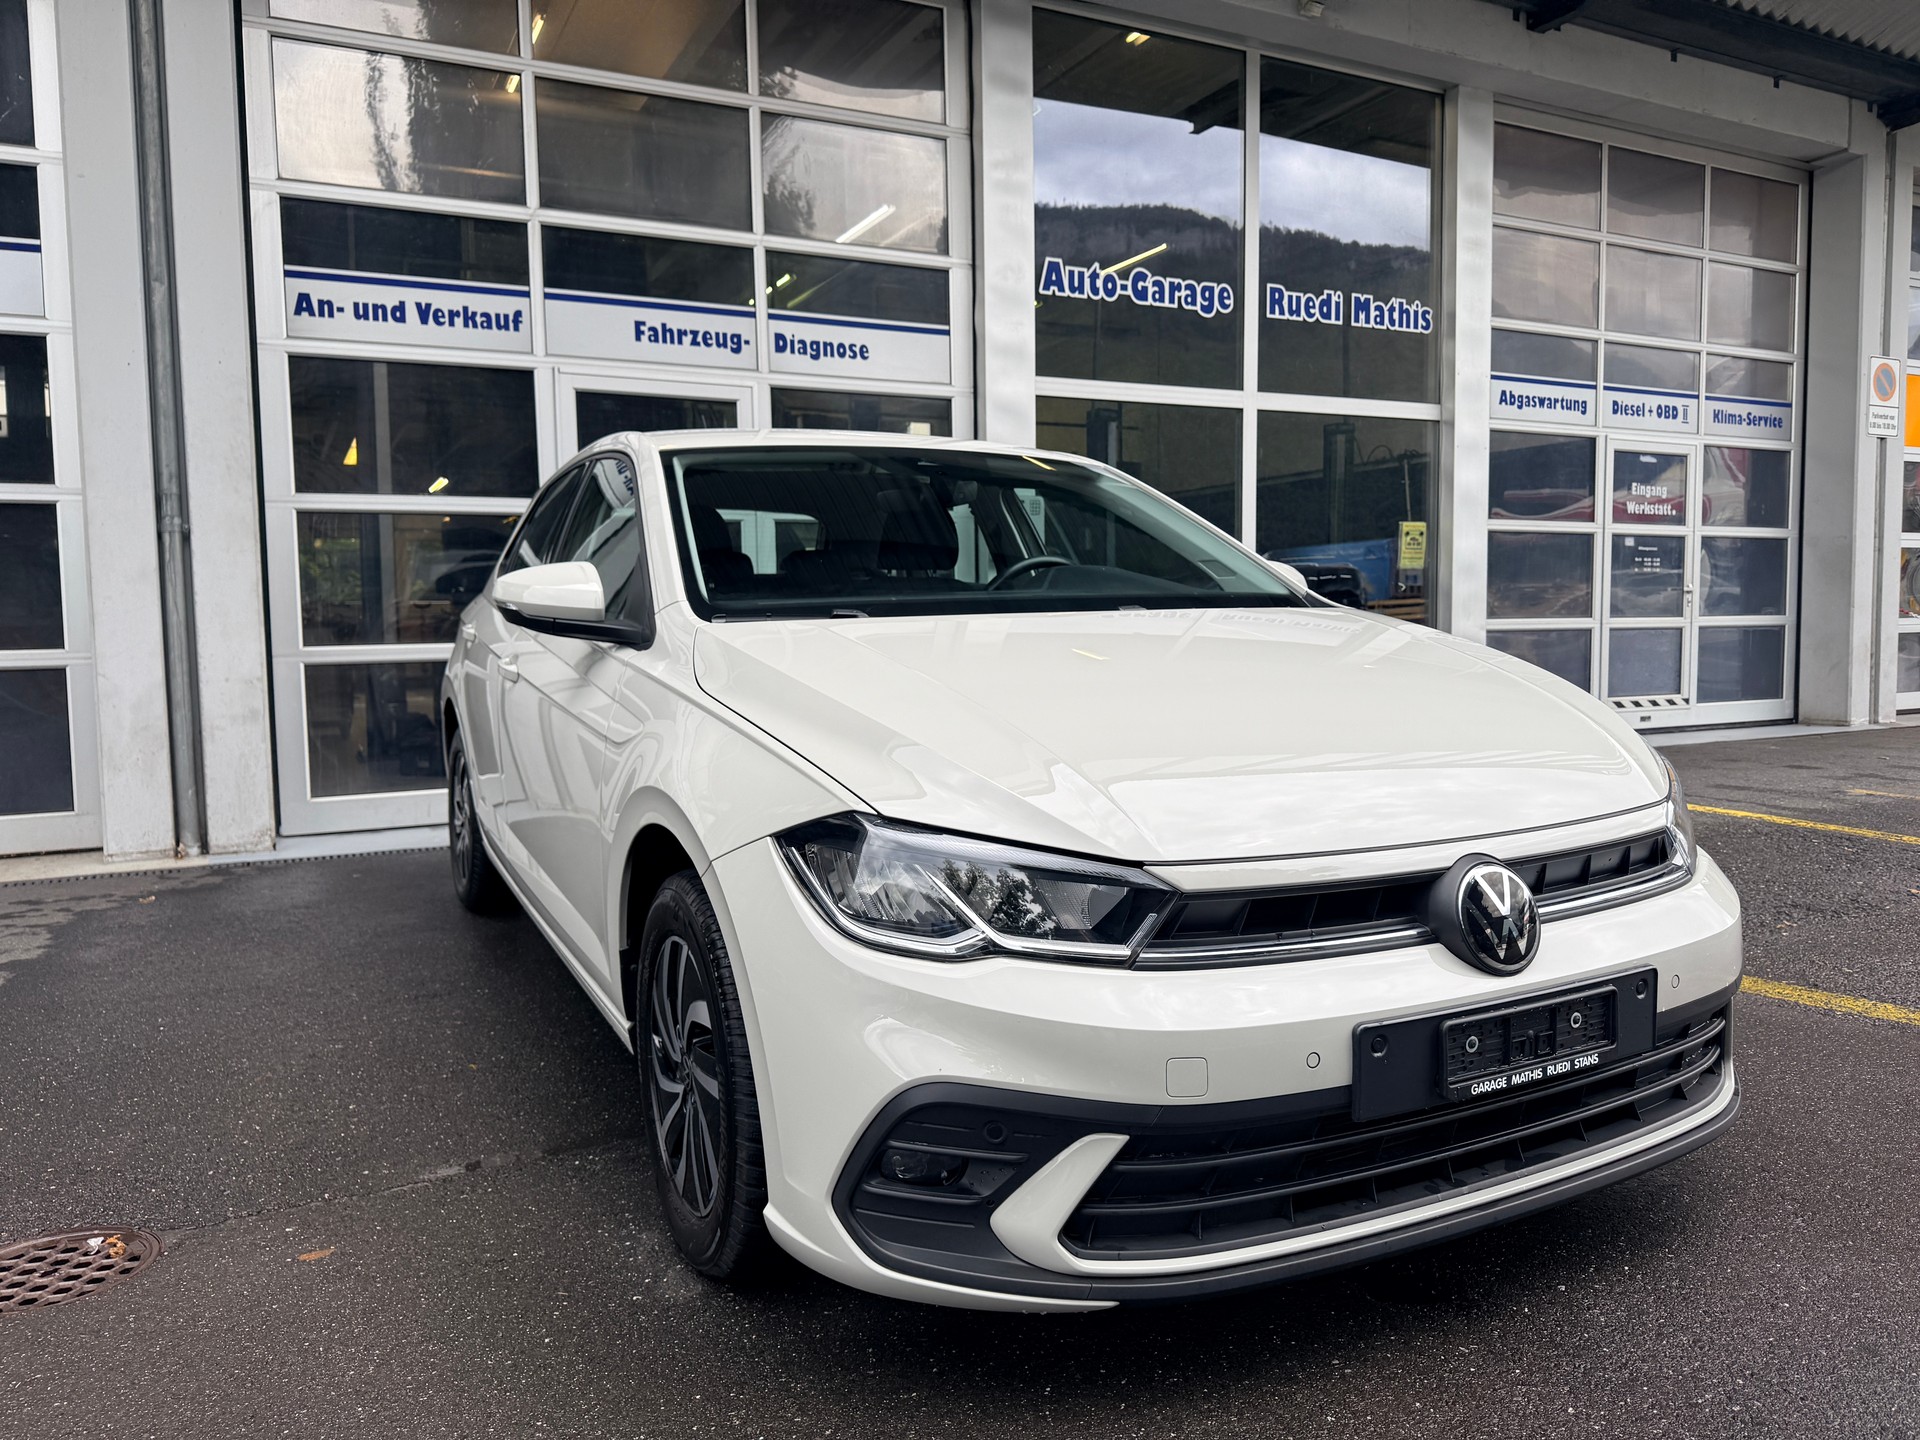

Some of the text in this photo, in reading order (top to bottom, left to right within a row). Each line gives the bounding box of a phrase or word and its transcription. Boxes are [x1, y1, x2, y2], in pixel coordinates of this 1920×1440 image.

[1039, 256, 1433, 334] Auto-Garage Ruedi Mathis
[294, 293, 523, 332] An- und Verkauf
[634, 320, 870, 361] Fahrzeug- Diagnose
[1499, 389, 1587, 416] Abgaswartung
[1612, 399, 1645, 417] Diesel
[1647, 405, 1654, 417] +
[1656, 404, 1679, 420] OBD
[1713, 408, 1783, 429] Klima-Service
[1631, 482, 1667, 499] Eingang
[1626, 501, 1676, 516] Werkstatt.
[1471, 1054, 1599, 1095] GARAGE MATHIS RUEDI STANS
